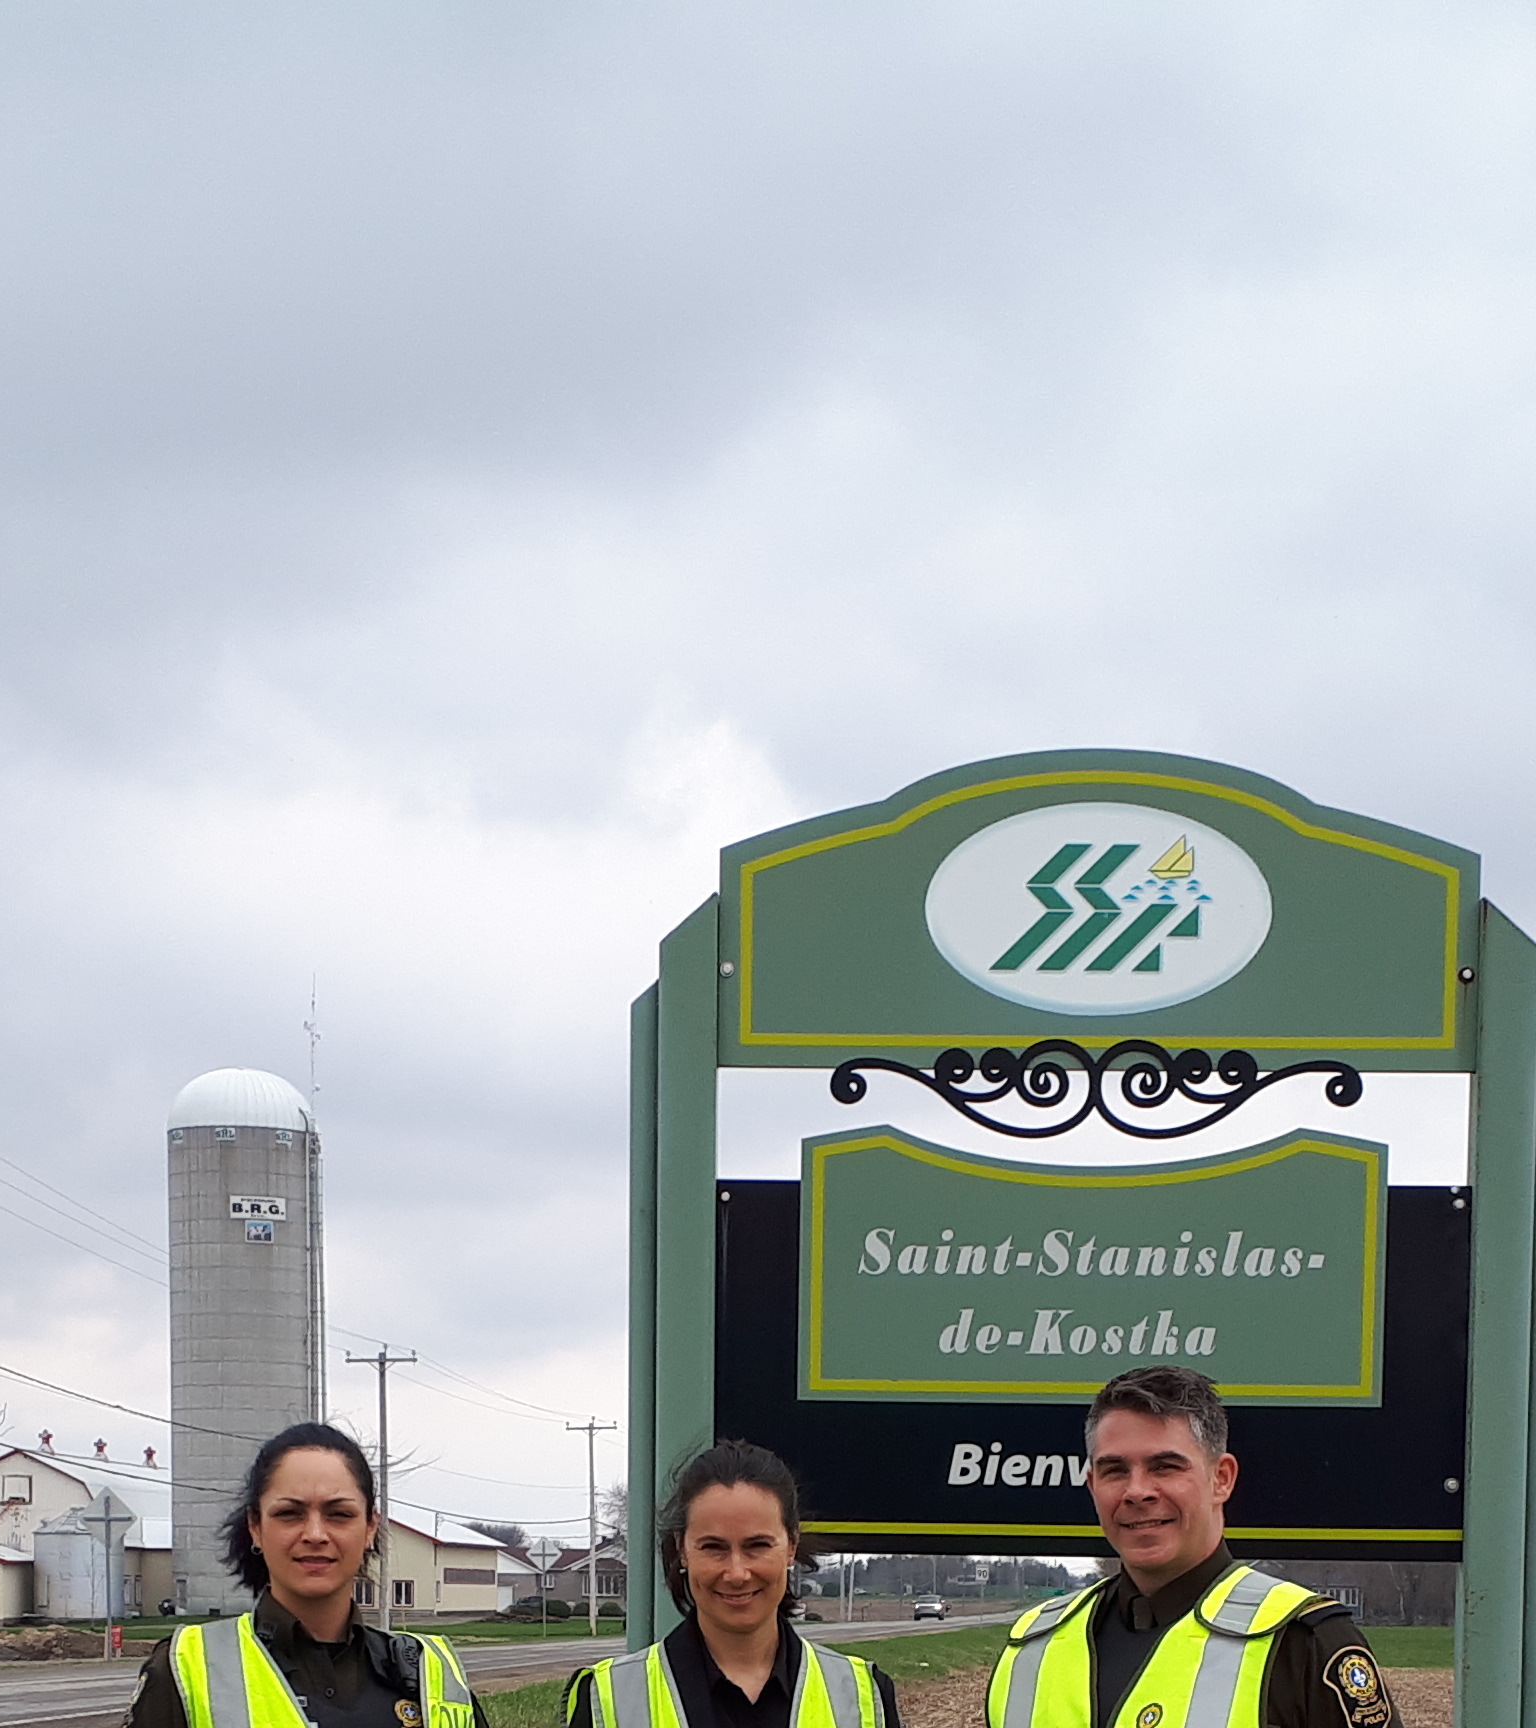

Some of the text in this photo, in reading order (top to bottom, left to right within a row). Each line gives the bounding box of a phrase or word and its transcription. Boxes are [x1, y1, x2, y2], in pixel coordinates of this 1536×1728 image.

[232, 1203, 284, 1215] B.R.G.
[858, 1228, 1325, 1278] Saint-Stanislas-
[938, 1308, 1217, 1356] de-Kostka
[948, 1441, 1090, 1487] Bienv
